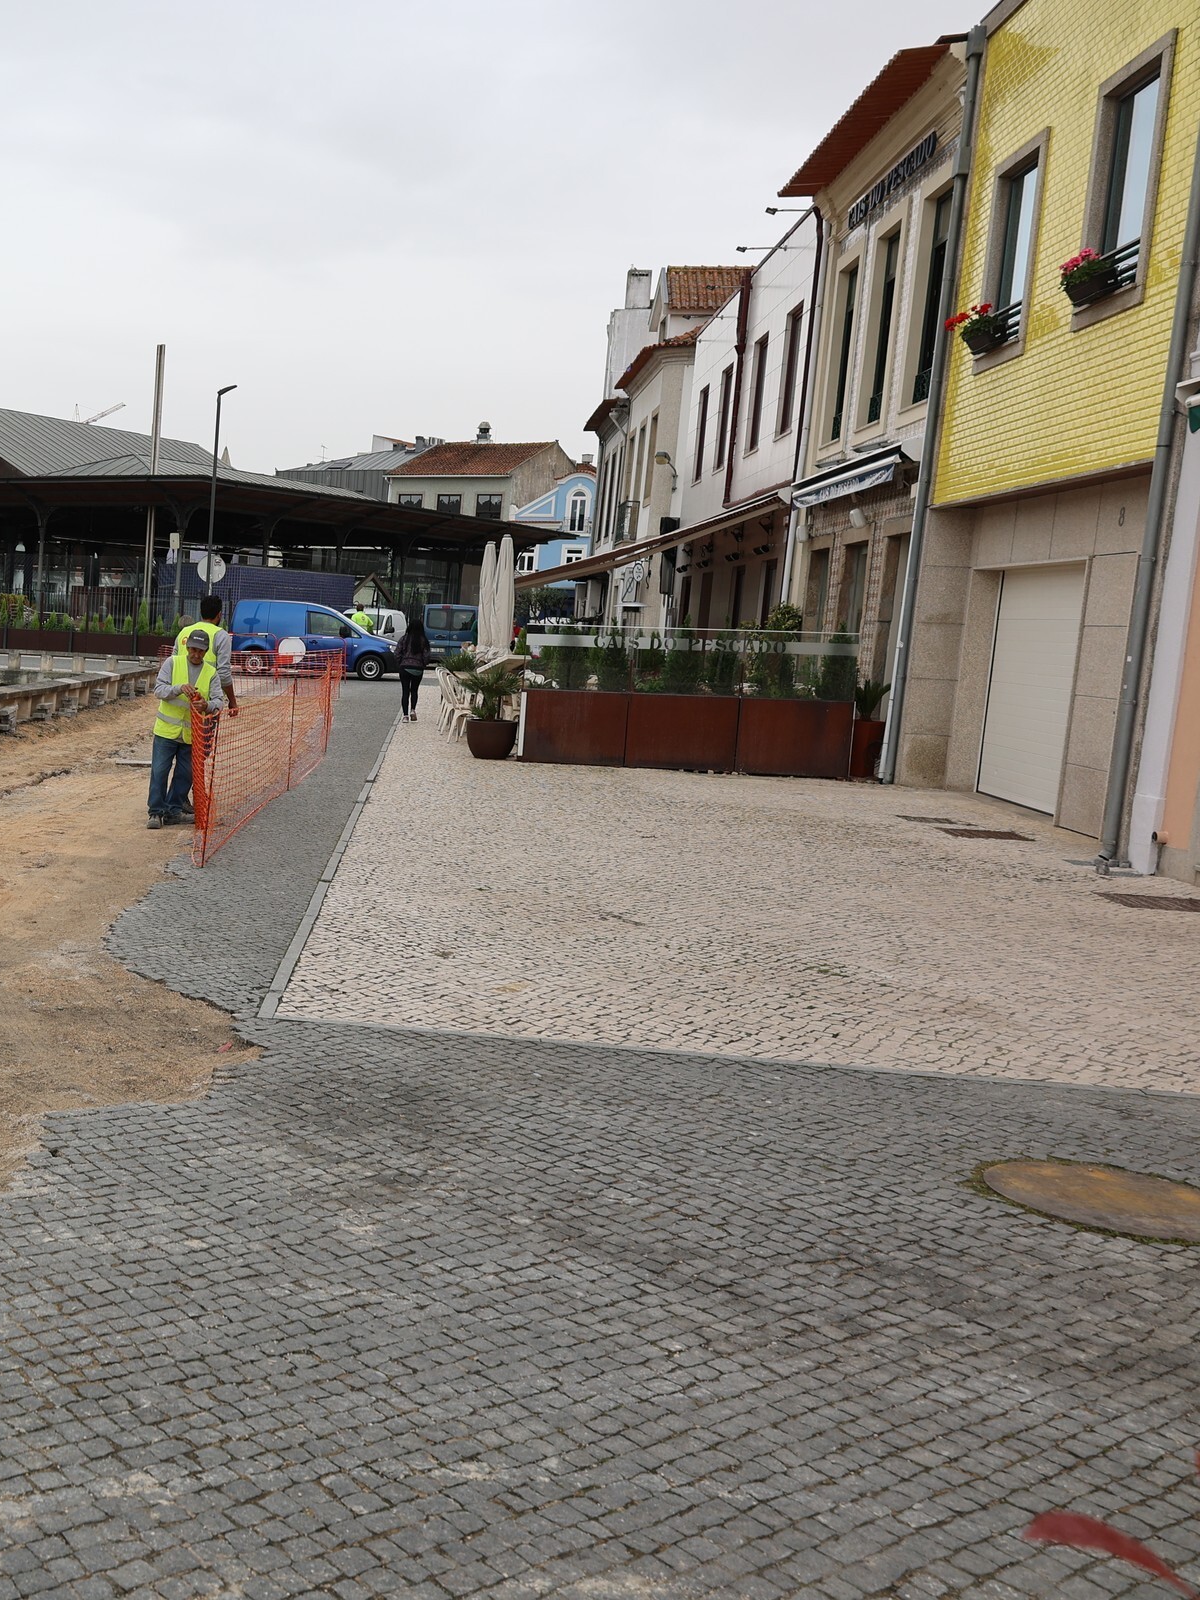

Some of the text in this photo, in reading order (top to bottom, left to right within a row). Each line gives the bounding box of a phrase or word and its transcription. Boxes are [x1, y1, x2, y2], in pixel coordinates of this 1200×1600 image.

[869, 181, 886, 211] DO
[885, 130, 938, 196] PESCADO
[1118, 506, 1126, 527] 8
[594, 635, 787, 654] CAIS DO PESCADO
